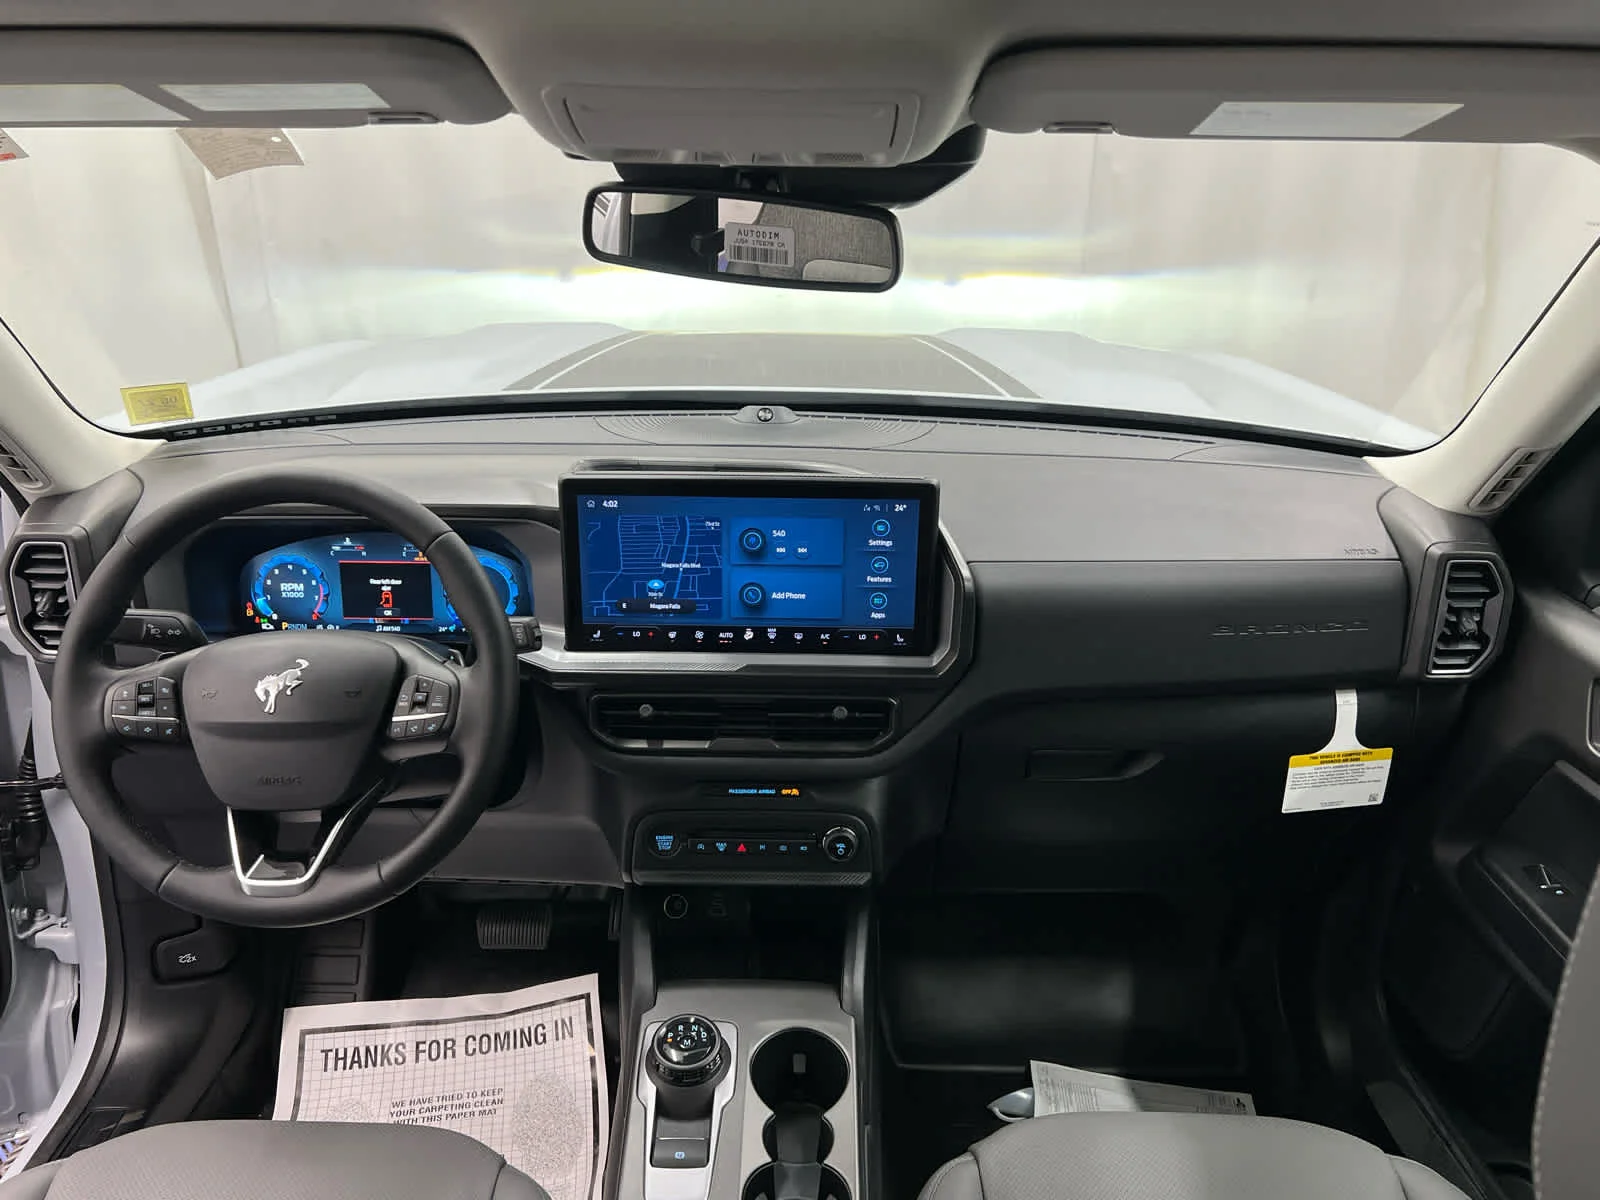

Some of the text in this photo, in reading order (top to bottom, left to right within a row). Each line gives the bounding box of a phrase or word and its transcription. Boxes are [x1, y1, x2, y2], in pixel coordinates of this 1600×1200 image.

[738, 228, 780, 240] AUTODIM
[602, 500, 618, 508] 4:02
[280, 583, 304, 591] RPM
[320, 1016, 574, 1072] THANKS FOR COMING IN
[409, 1096, 433, 1106] HAVE
[436, 1093, 463, 1102] TRIED
[467, 1091, 477, 1099] TO
[481, 1088, 503, 1097] KEEP
[390, 1098, 504, 1118] YOUR CARPETING CLEAN
[422, 1114, 442, 1124] THIS
[446, 1111, 475, 1120] PAPER
[479, 1108, 496, 1117] MAT
